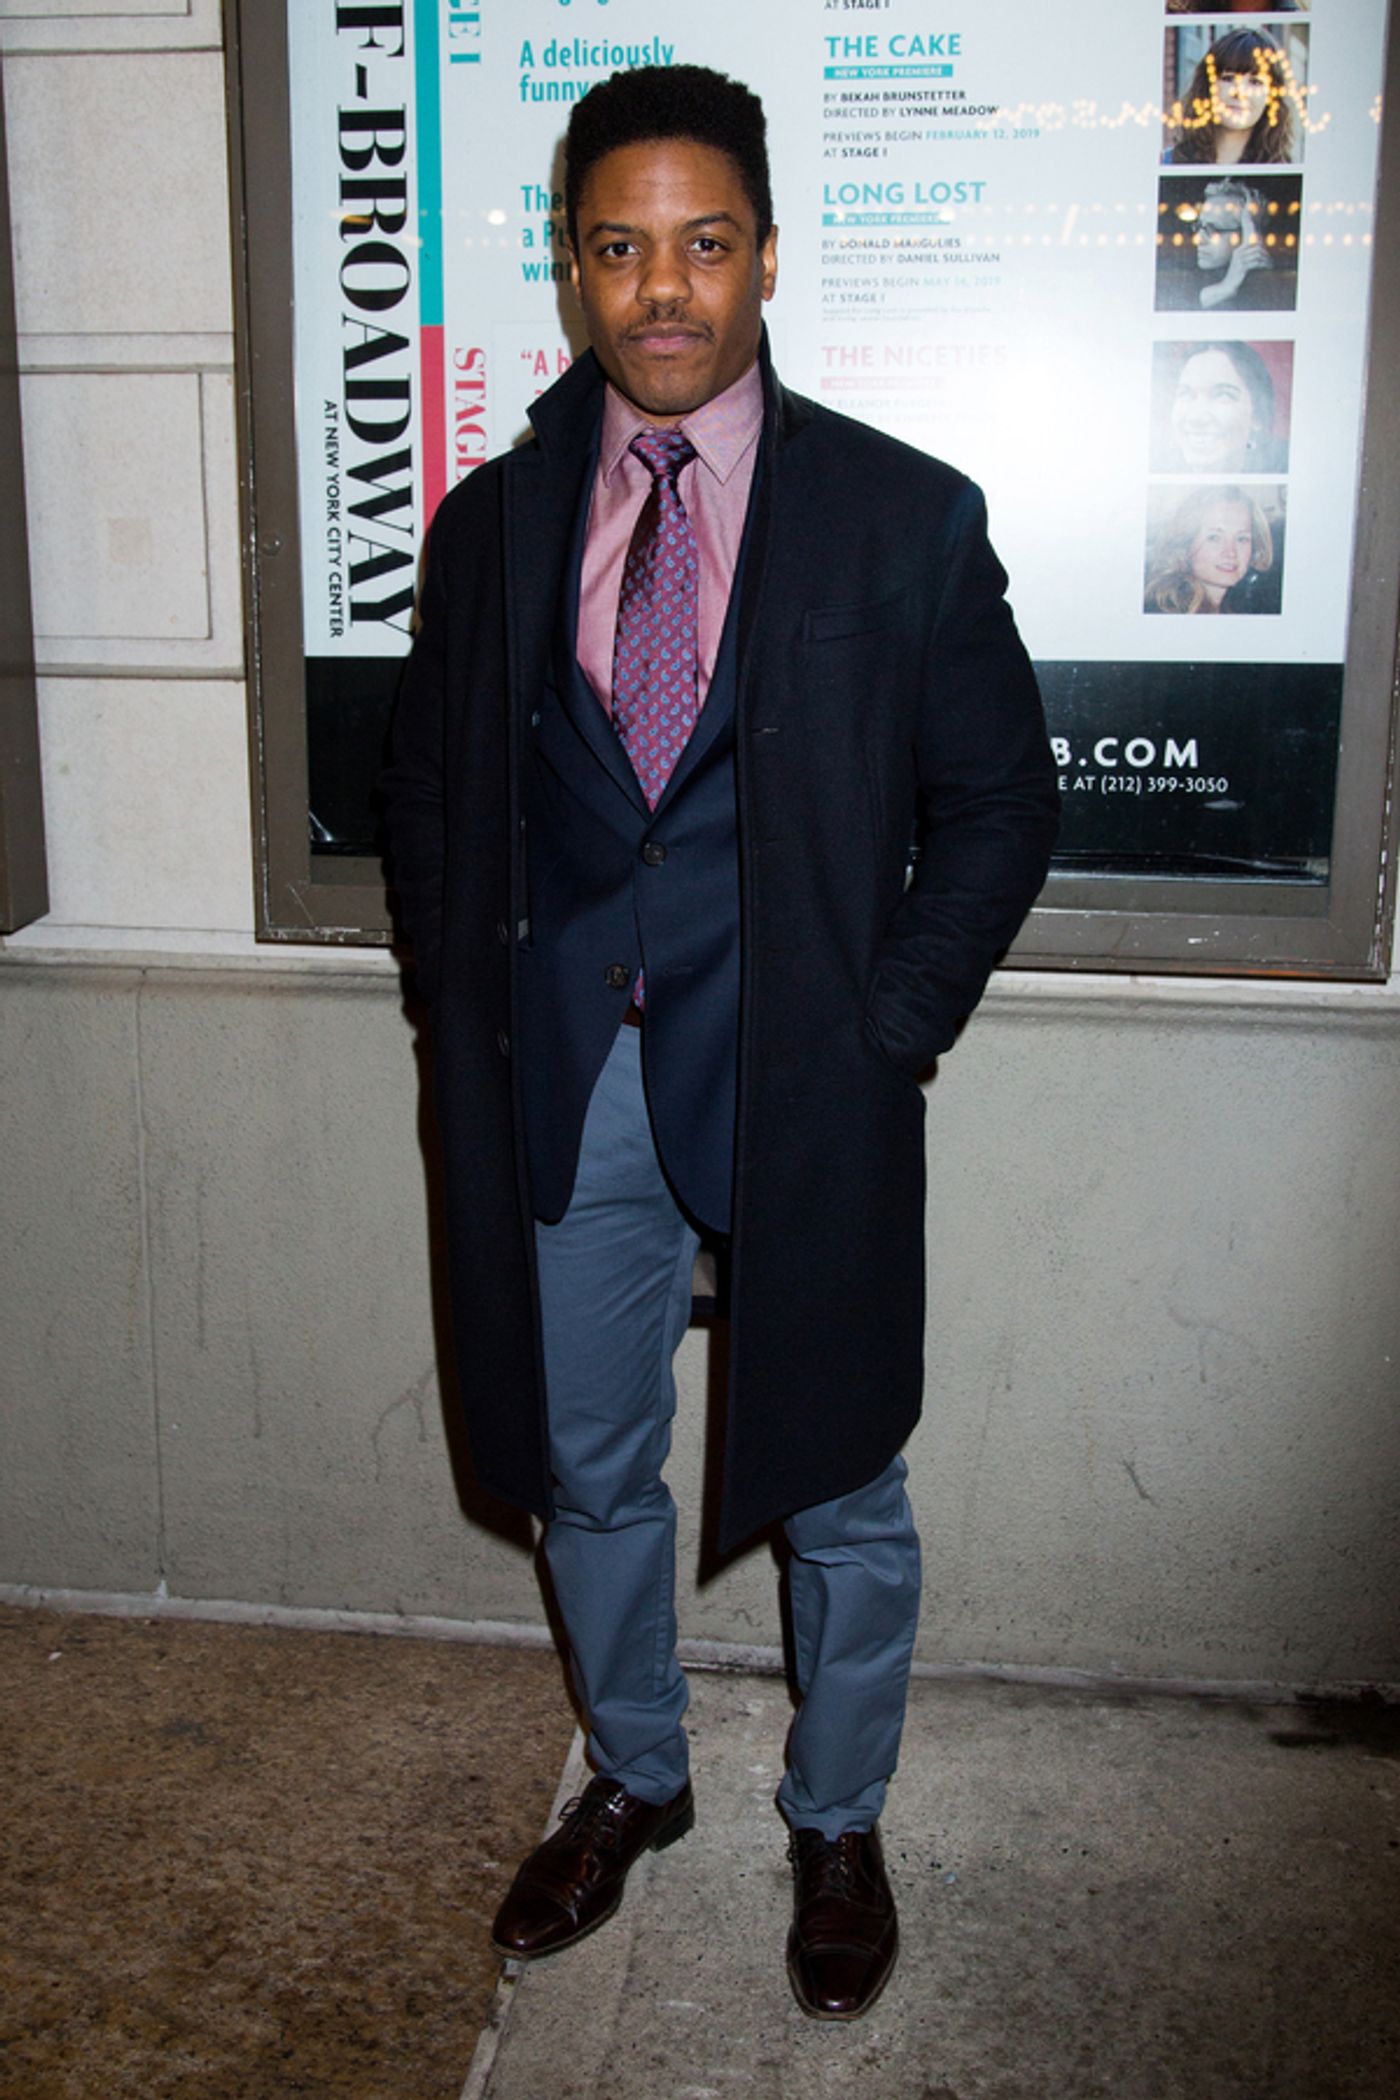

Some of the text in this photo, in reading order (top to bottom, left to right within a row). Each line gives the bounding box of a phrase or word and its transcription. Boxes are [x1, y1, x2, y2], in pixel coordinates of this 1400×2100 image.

[824, 0, 839, 10] AT
[842, 0, 883, 9] STAGE
[519, 36, 675, 68] A deliciously
[824, 33, 962, 58] THE CAKE
[834, 66, 943, 78] NEW YORK PREMIERE
[824, 90, 966, 103] BY BEKAH BRUNSTETTER
[824, 105, 1000, 119] DIRECTED BY LYNNE MEADOW
[823, 132, 881, 143] PREVIEWS
[884, 130, 922, 142] BEGIN
[926, 129, 988, 141] FEBRUARY
[1013, 128, 1040, 139] 2019
[823, 149, 838, 158] AT
[841, 148, 879, 158] STAGE
[521, 184, 564, 212] The
[823, 181, 987, 206] LONG LOST
[522, 228, 534, 248] a
[822, 239, 835, 249] BY
[839, 237, 890, 248] DONALD
[821, 251, 1000, 265] DIRECTED BY DANIEL SULLIVAN
[821, 277, 880, 288] PREVIEWS
[883, 277, 919, 287] BEGIN
[821, 294, 835, 304] AT
[839, 293, 877, 304] STAGE
[821, 346, 875, 368] THE
[324, 399, 344, 638] AT NEW YORK CITY CENTER
[1073, 775, 1095, 791] AT
[1101, 775, 1142, 795] (212)
[1147, 776, 1228, 793] 399-3050
